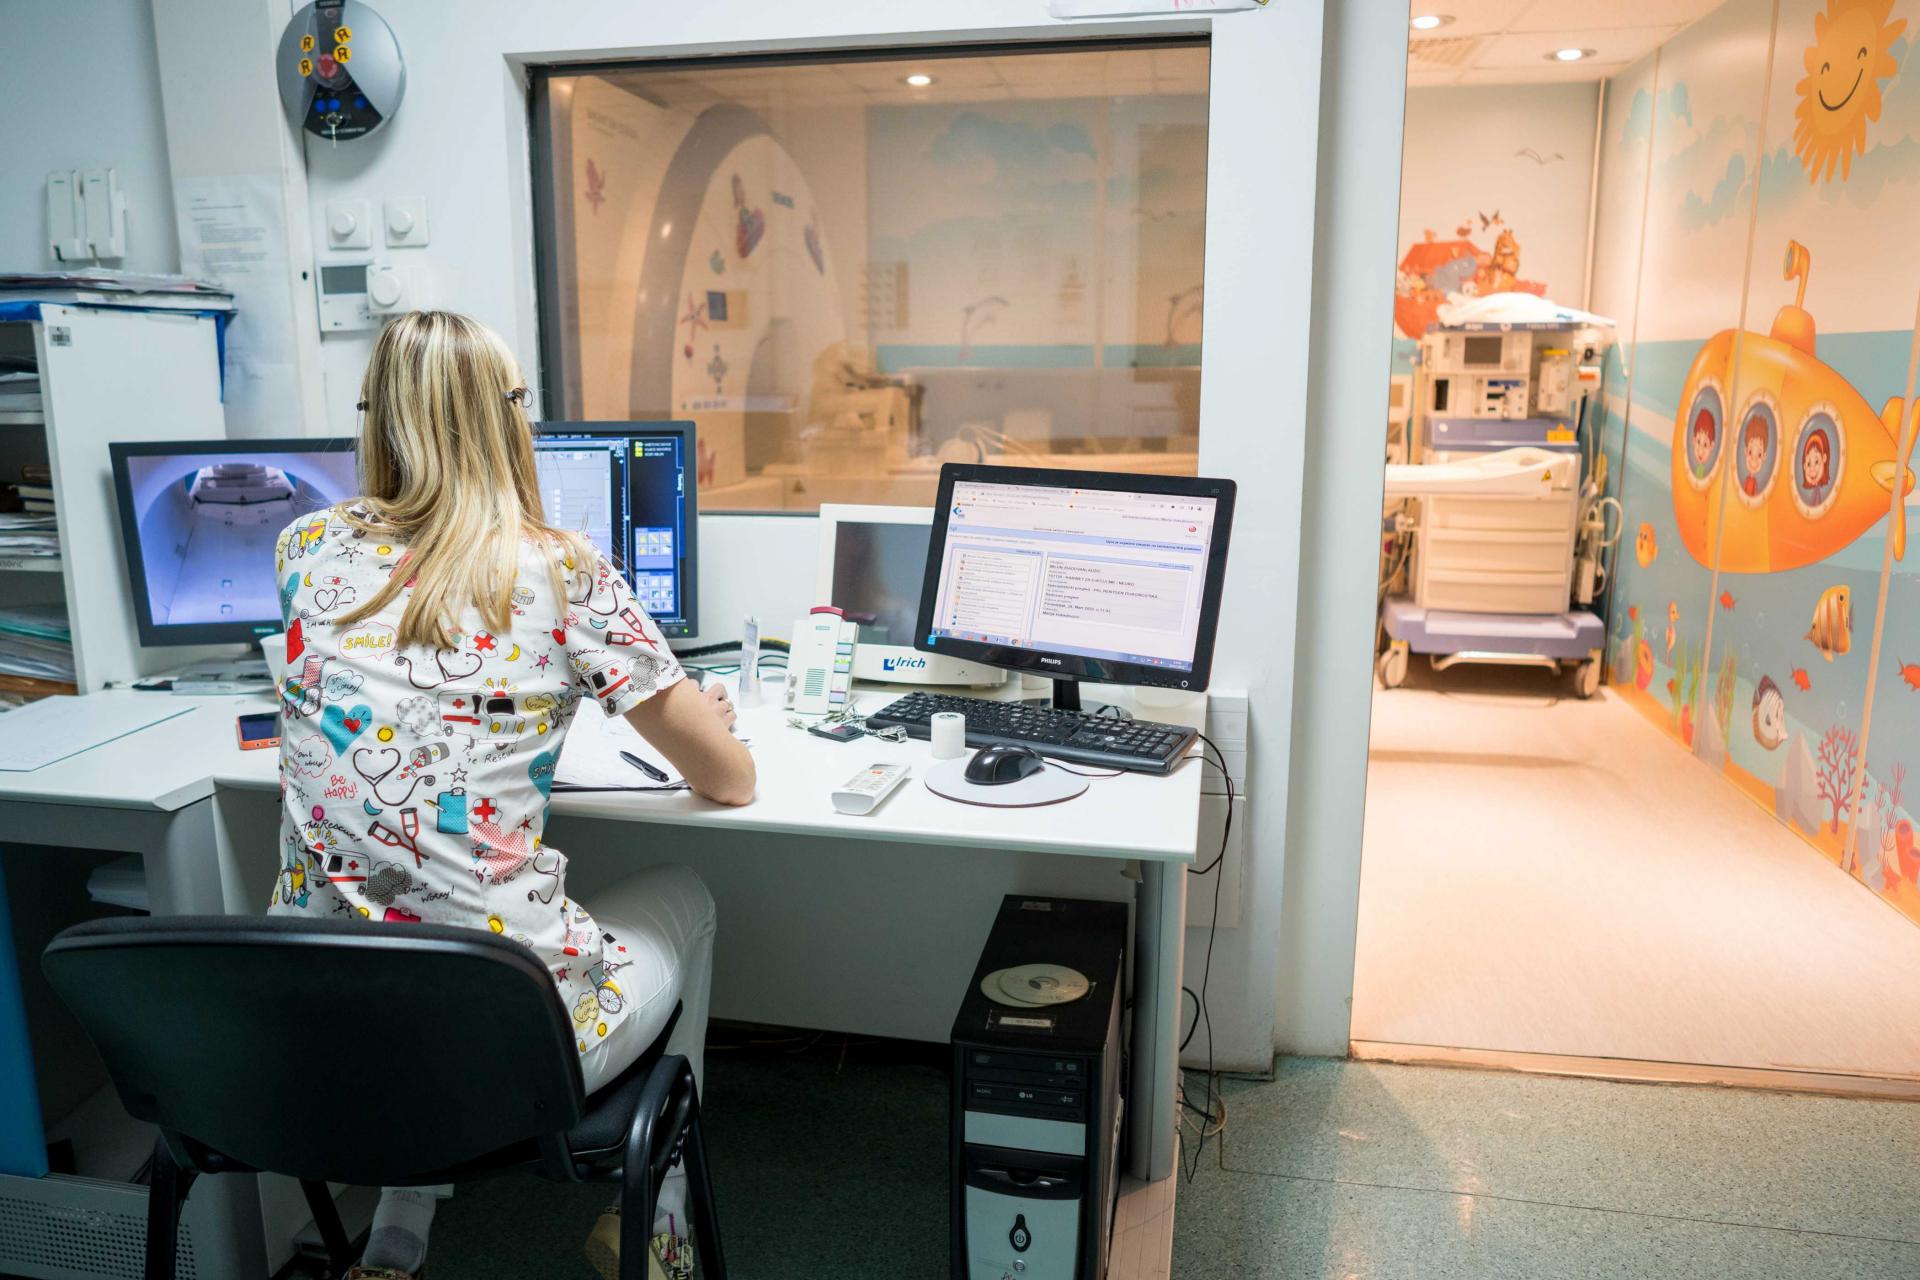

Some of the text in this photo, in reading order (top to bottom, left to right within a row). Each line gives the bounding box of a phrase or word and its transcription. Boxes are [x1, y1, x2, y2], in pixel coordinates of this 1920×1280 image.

[1040, 657, 1062, 666] PHILIPS
[330, 774, 347, 787] Be
[324, 782, 359, 800] Happy!
